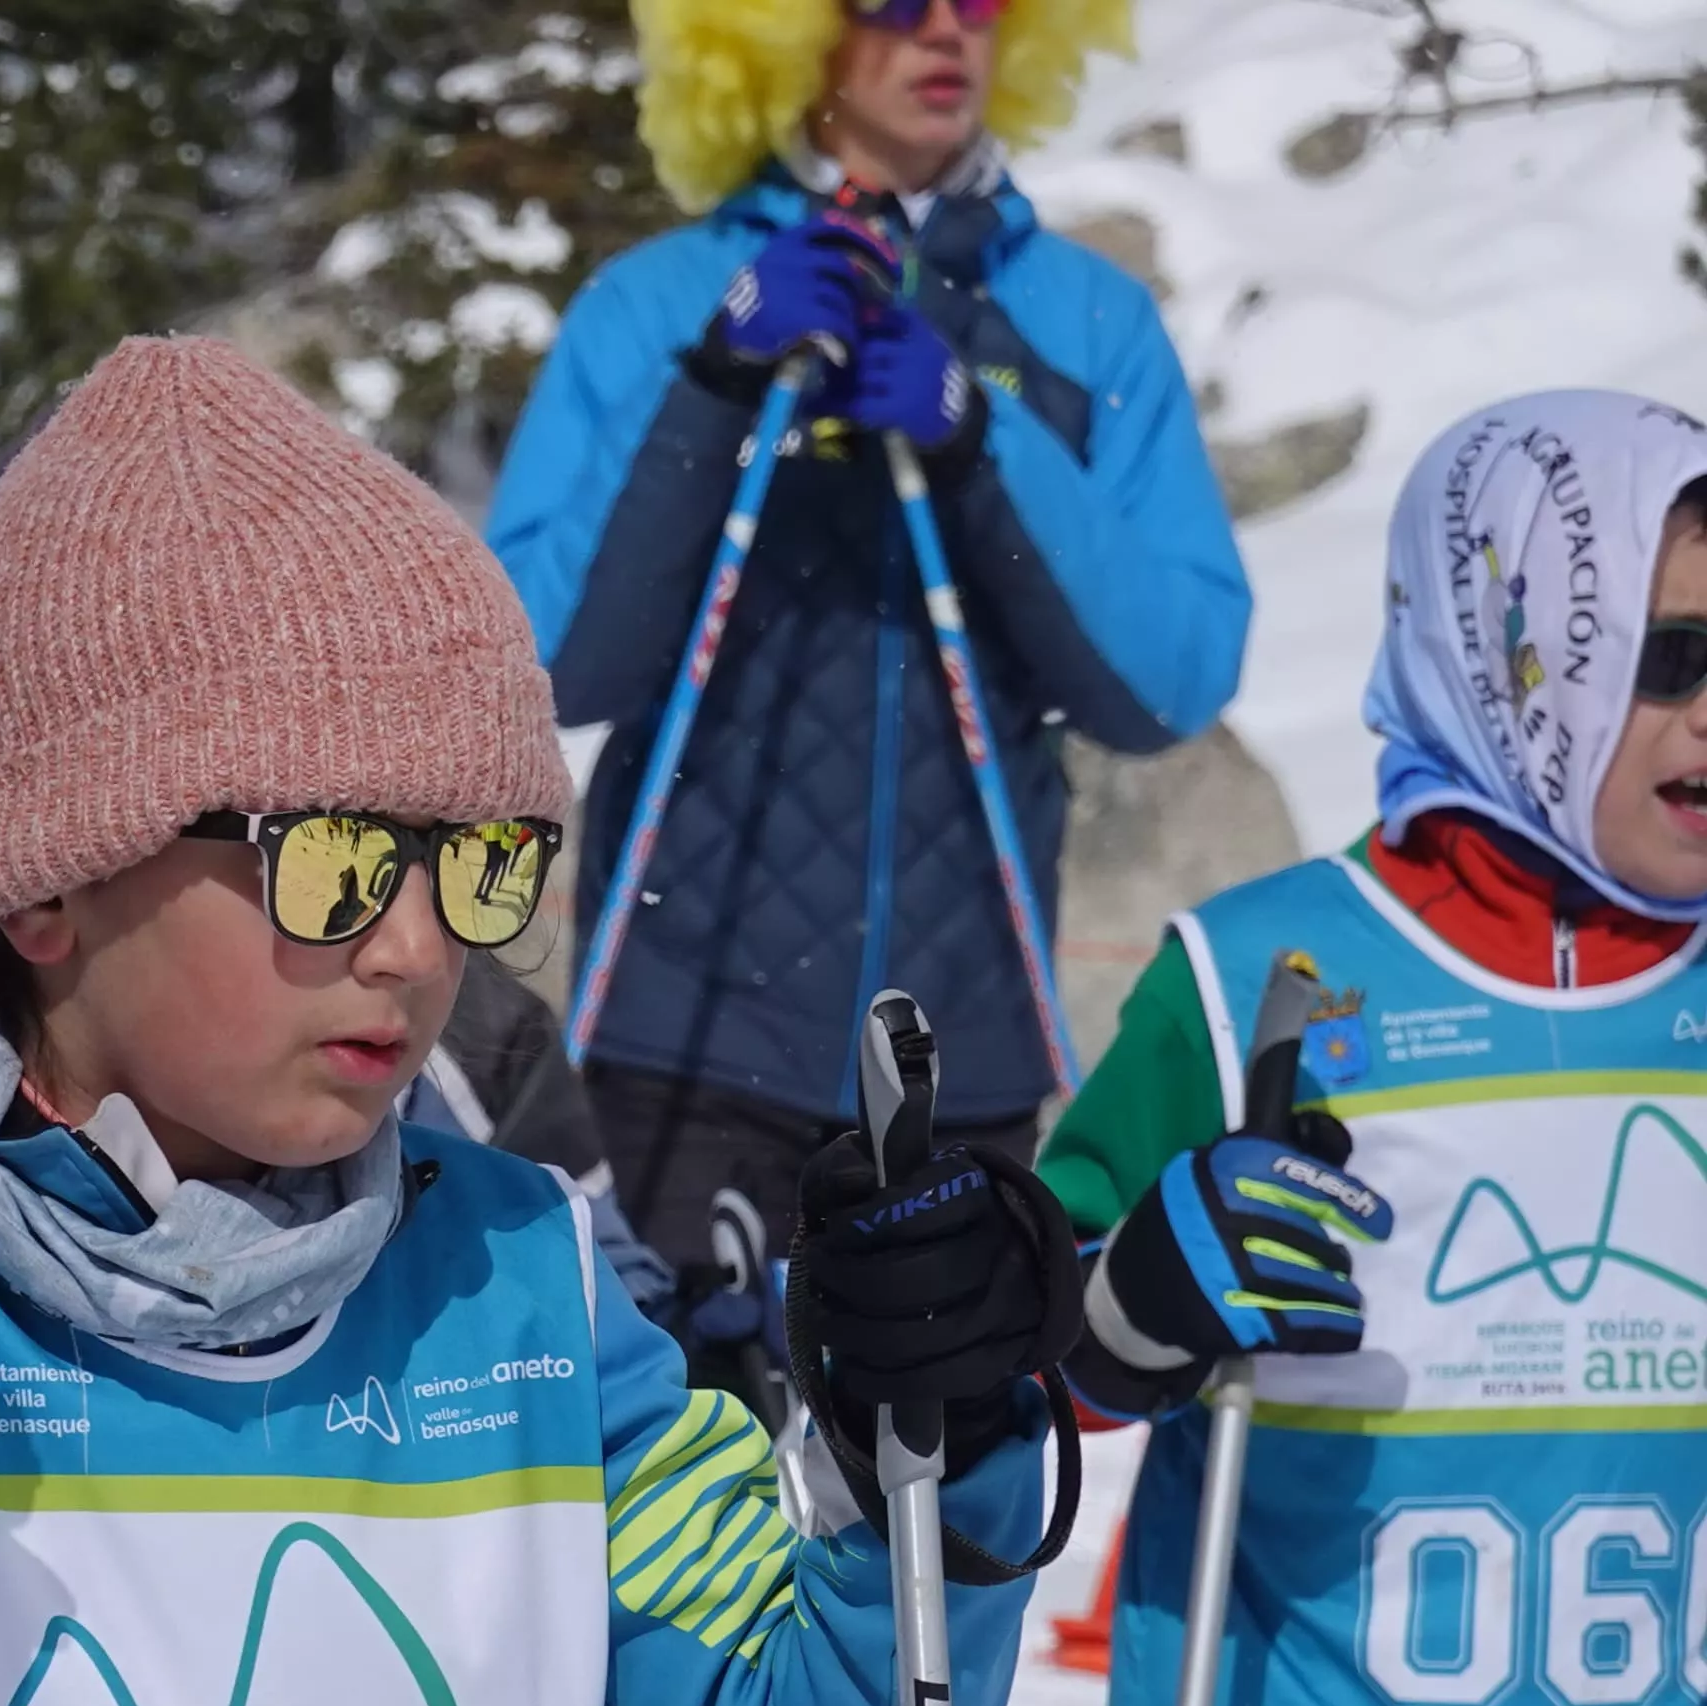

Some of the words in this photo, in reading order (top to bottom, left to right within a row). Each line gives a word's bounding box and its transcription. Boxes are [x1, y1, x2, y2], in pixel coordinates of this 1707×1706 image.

[1273, 1156, 1378, 1218] reusch
[1585, 1313, 1665, 1341] reino
[413, 1376, 469, 1399] reino
[470, 1374, 490, 1389] del
[491, 1354, 575, 1383] aneto
[1583, 1345, 1707, 1393] ane
[3, 1388, 46, 1408] villa
[421, 1408, 520, 1440] benasque
[425, 1407, 460, 1423] valle
